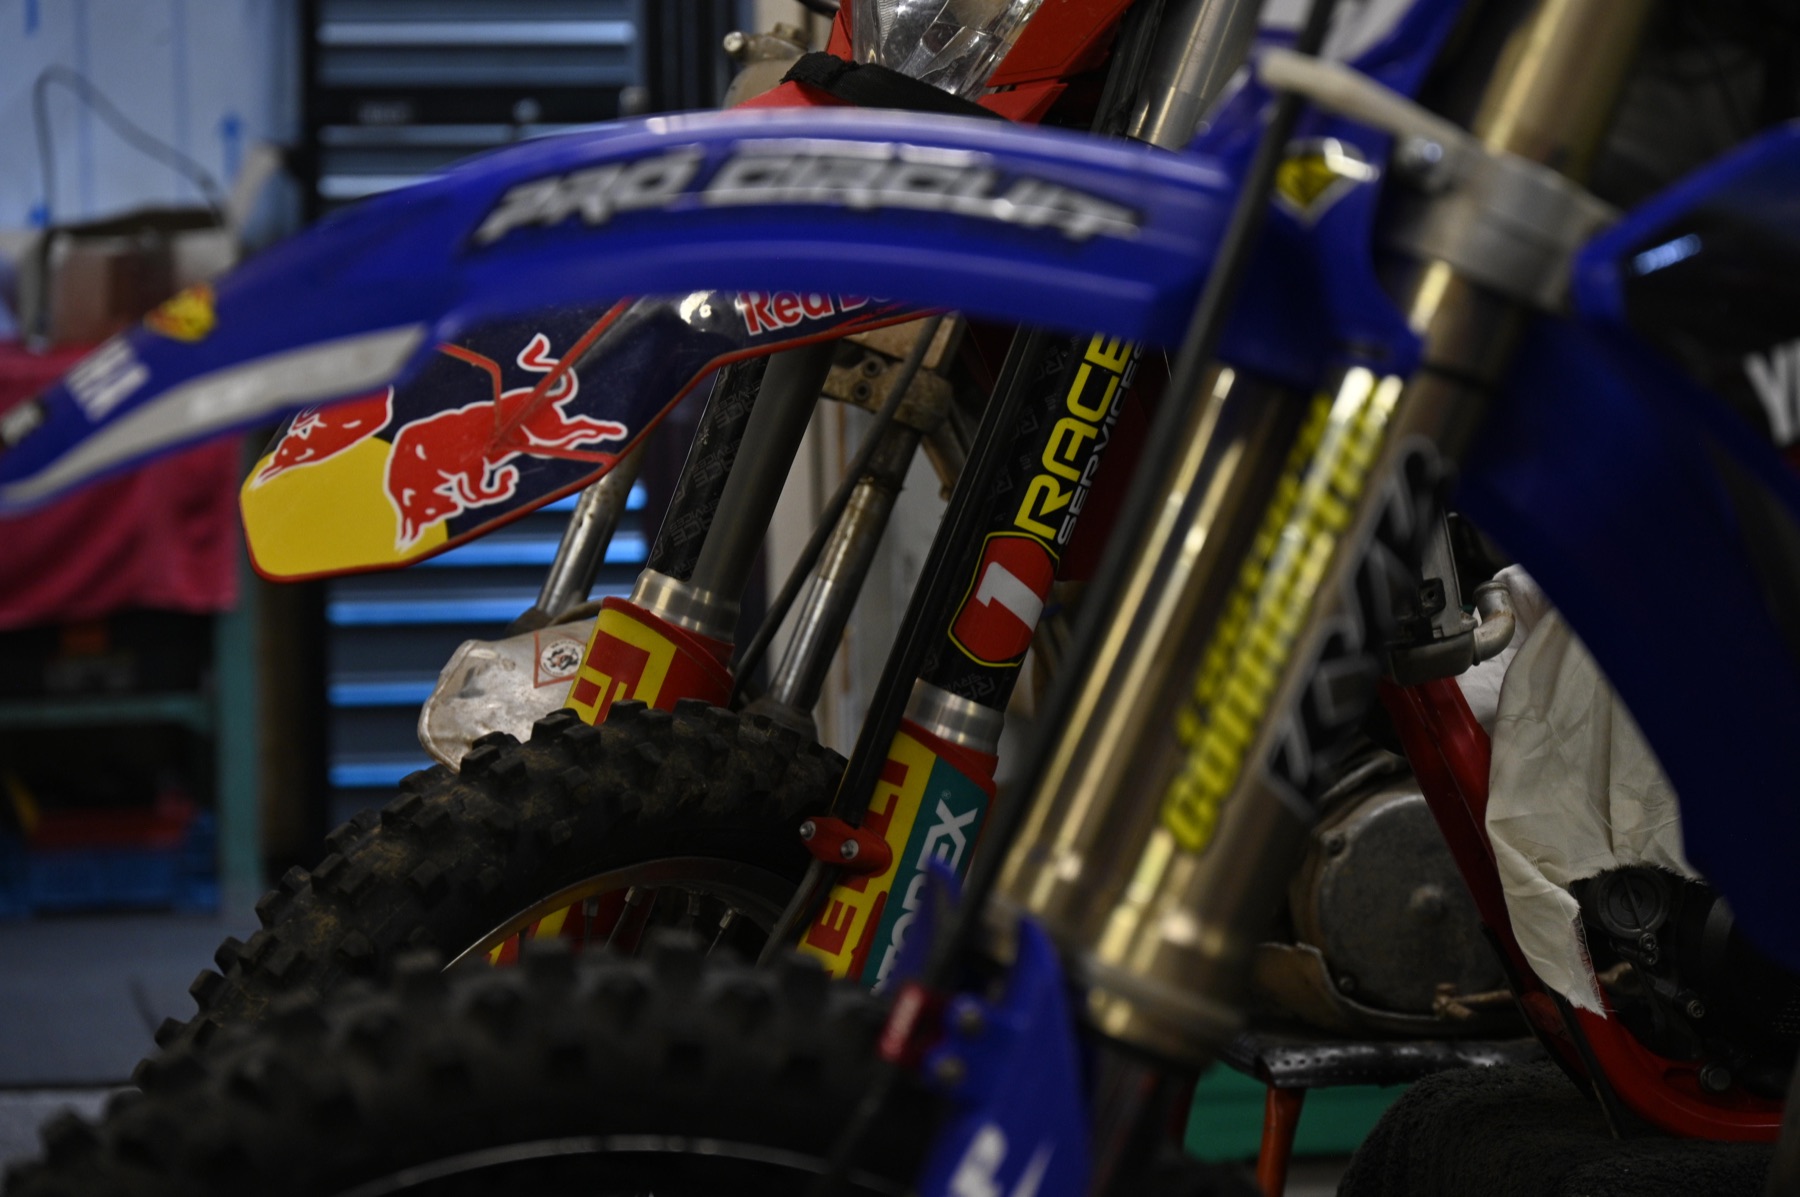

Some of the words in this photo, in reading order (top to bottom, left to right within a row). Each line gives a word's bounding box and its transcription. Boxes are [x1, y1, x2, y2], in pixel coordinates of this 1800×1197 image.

[473, 143, 706, 247] PRO
[703, 138, 1143, 241] CIRCUIT
[1013, 332, 1136, 541] RACE
[1057, 337, 1145, 546] SERVICES
[975, 561, 1045, 633] 1
